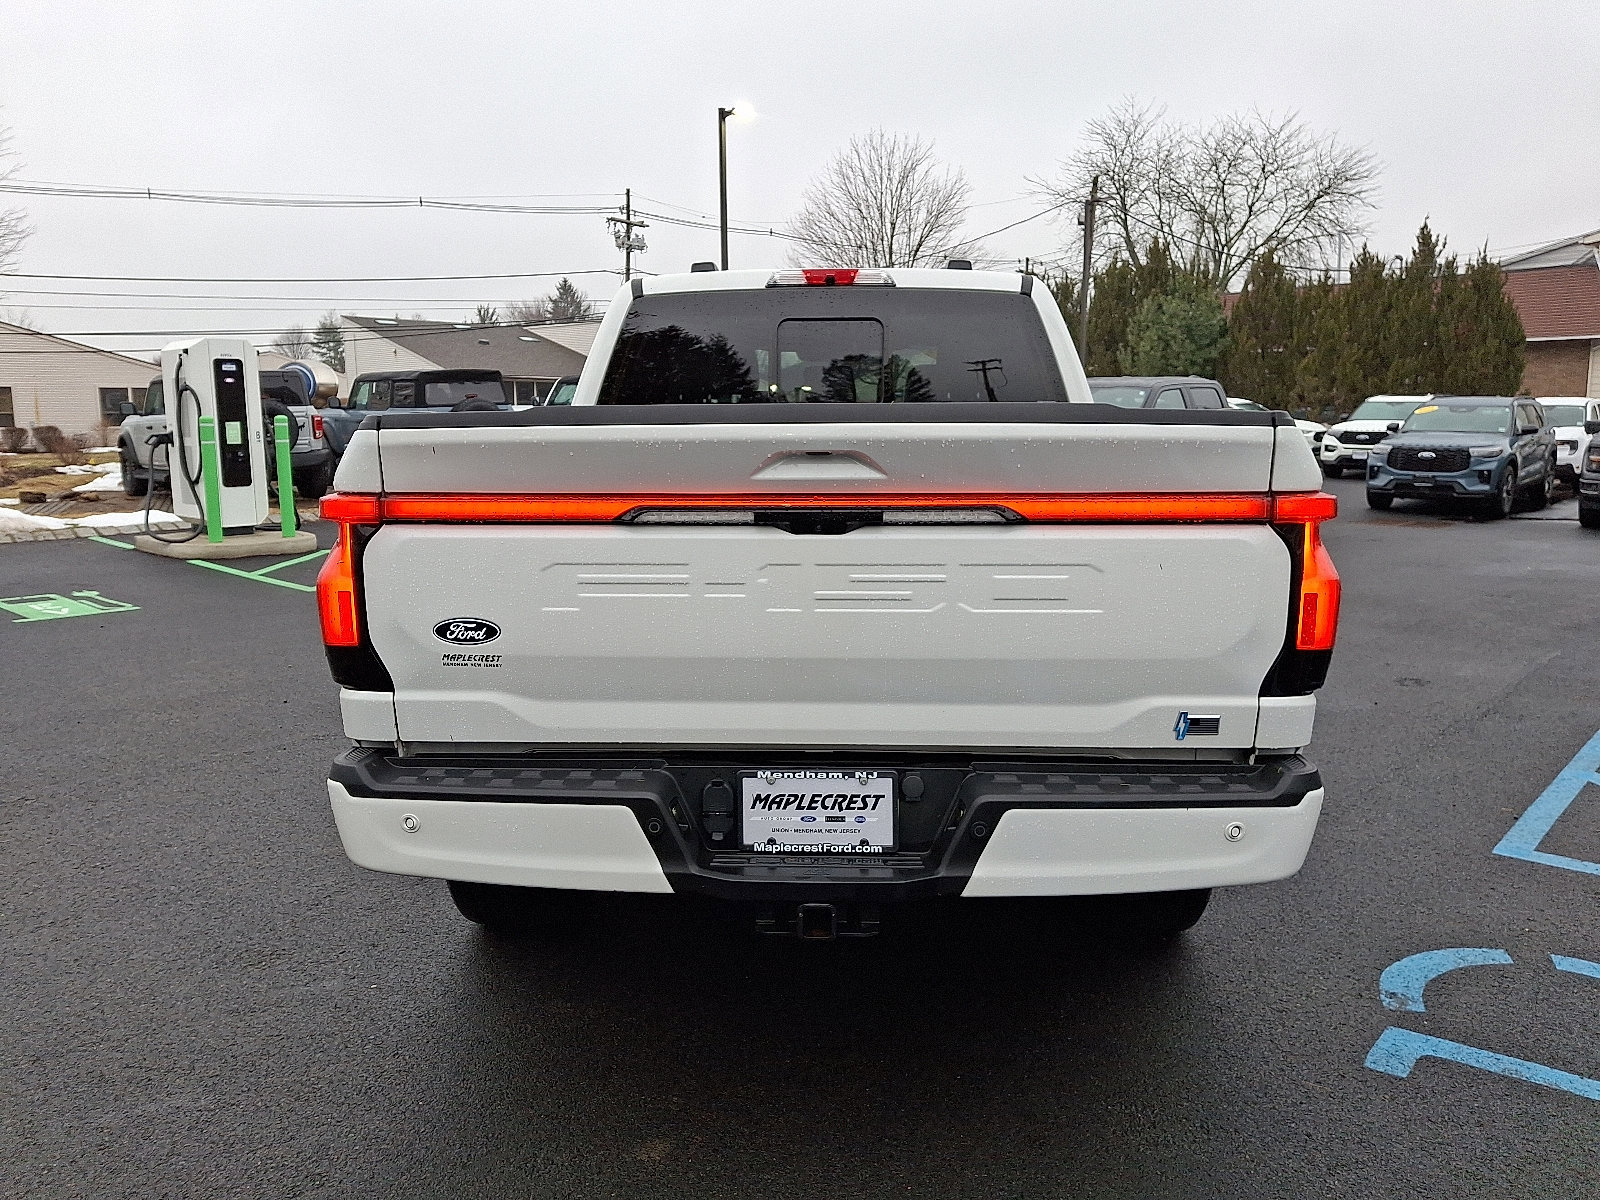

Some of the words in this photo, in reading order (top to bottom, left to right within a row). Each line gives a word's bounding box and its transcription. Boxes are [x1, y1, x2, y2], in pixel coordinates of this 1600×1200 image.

[540, 562, 1104, 613] F-150
[446, 622, 487, 640] Ford
[442, 654, 502, 662] MAPLECREST
[757, 770, 849, 780] Mendham,
[855, 771, 878, 780] NJ
[750, 793, 886, 812] MAPLECREST
[753, 842, 883, 854] MaplecrestFord.com
